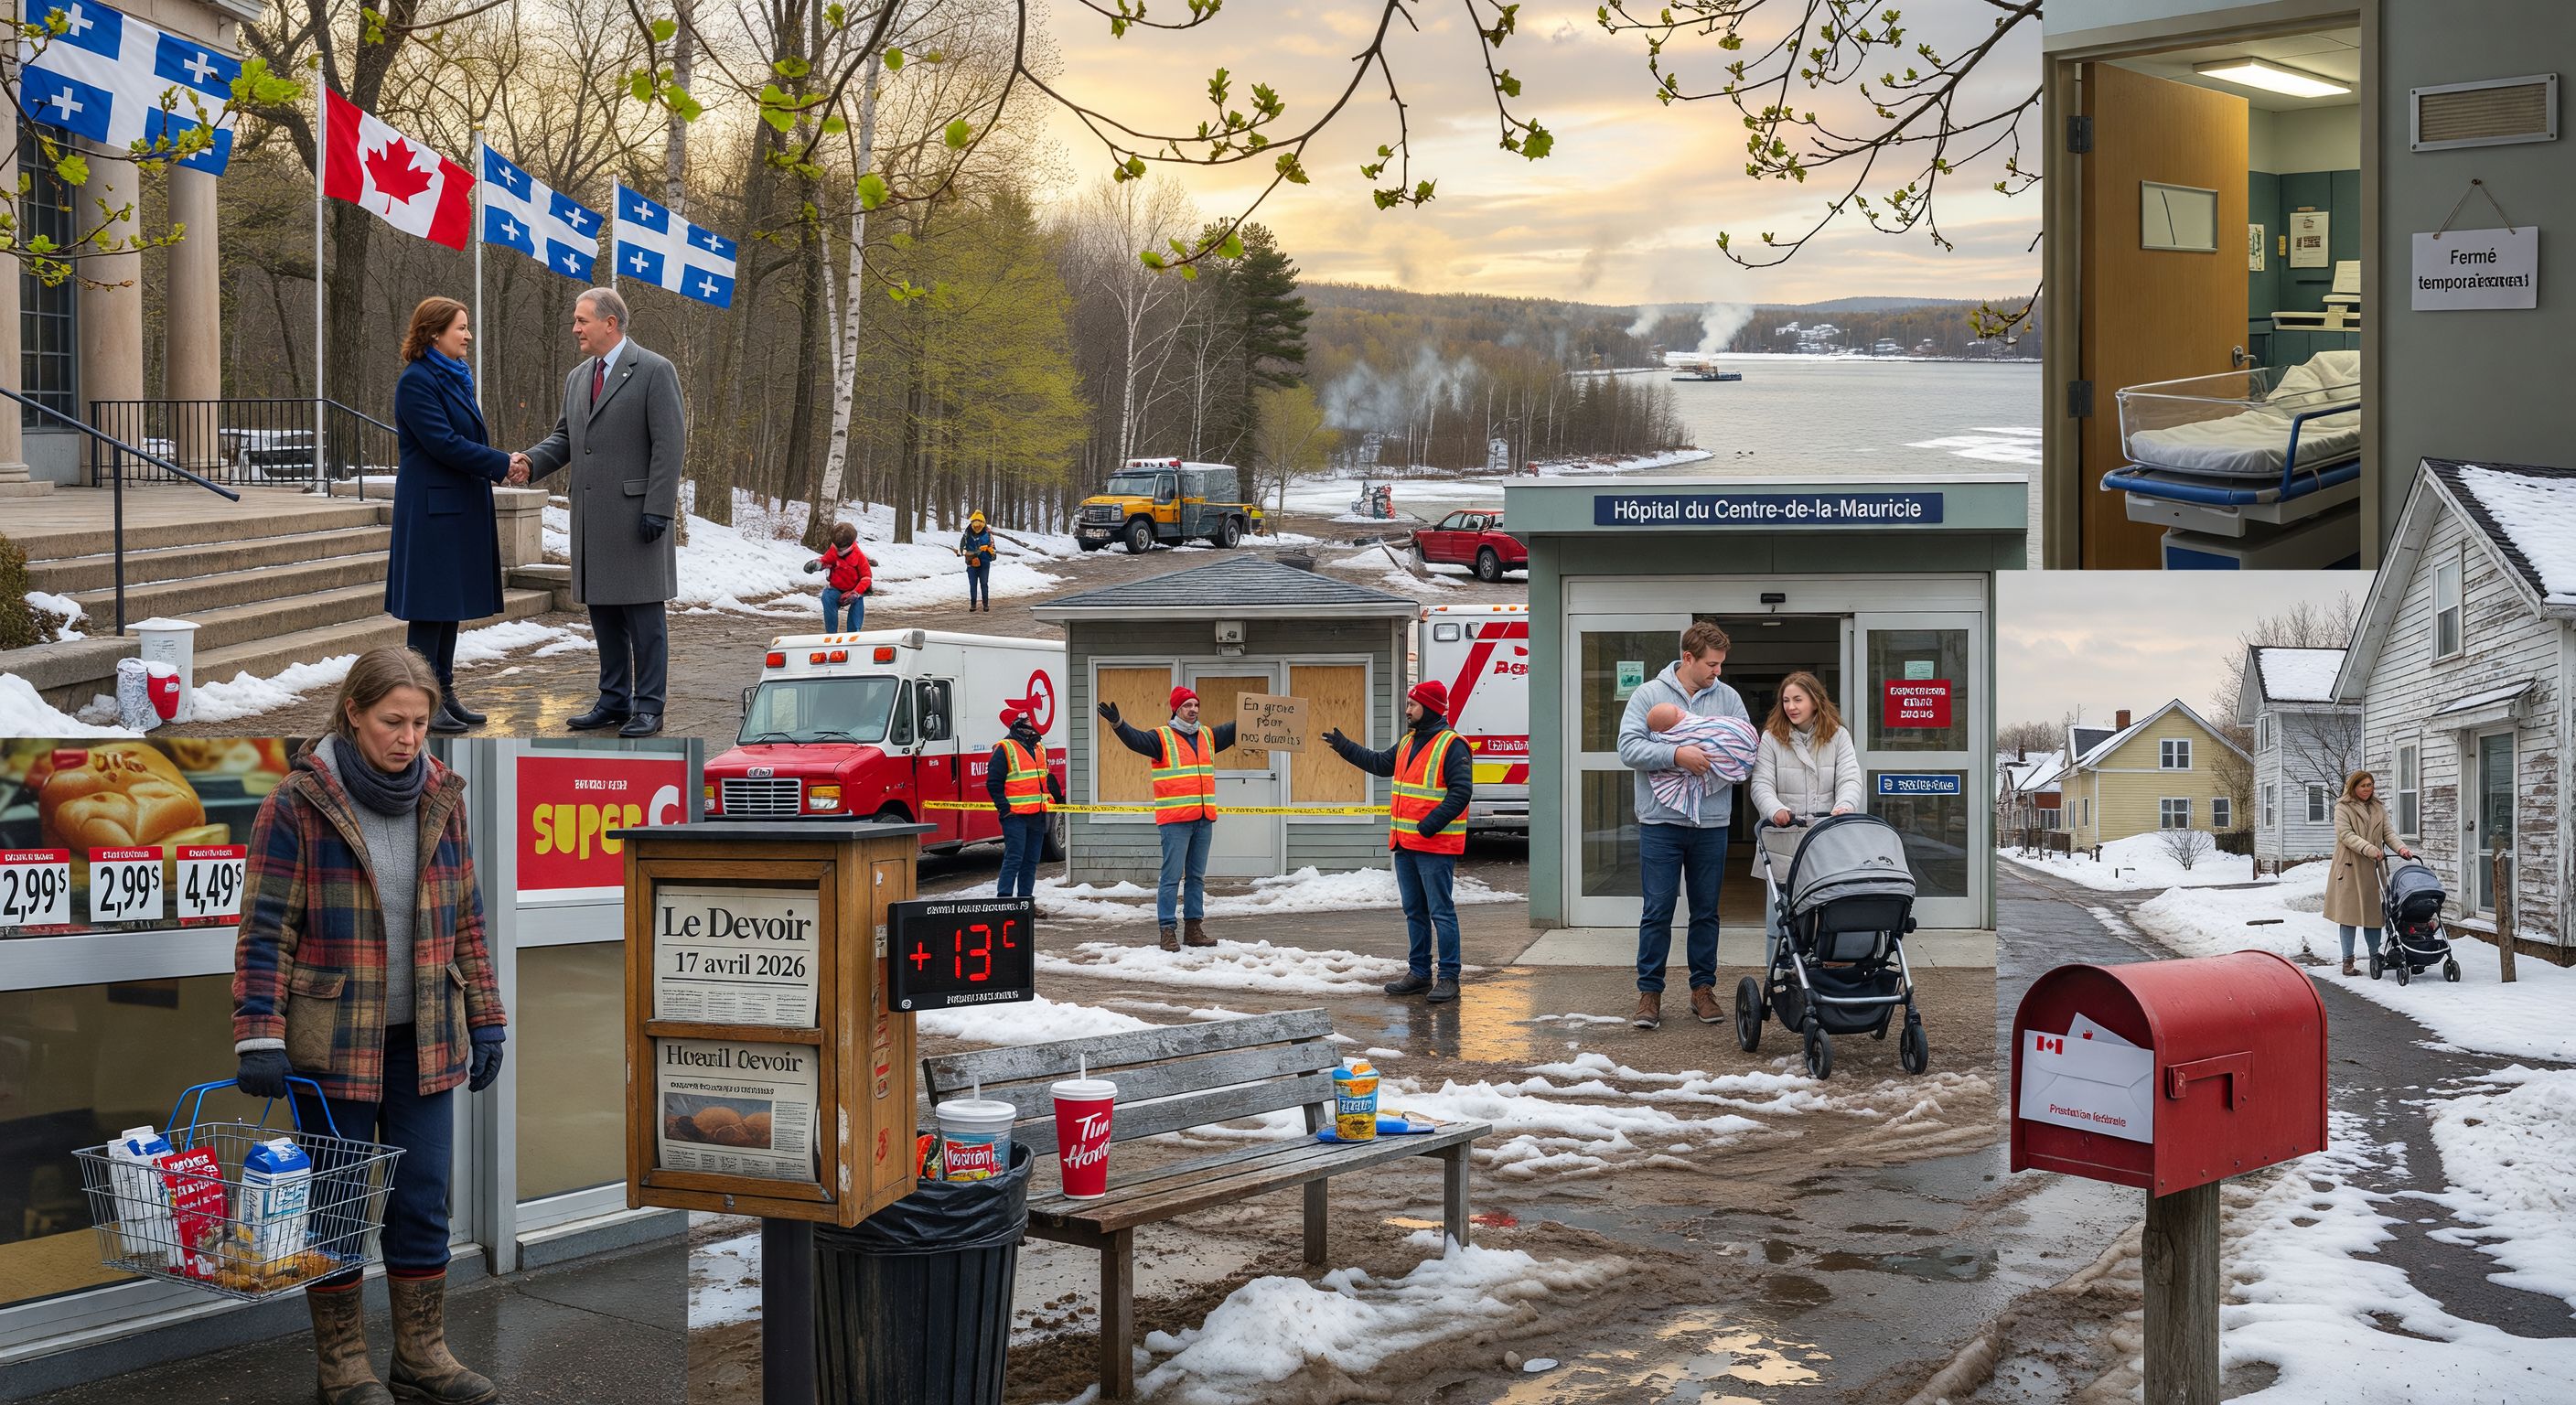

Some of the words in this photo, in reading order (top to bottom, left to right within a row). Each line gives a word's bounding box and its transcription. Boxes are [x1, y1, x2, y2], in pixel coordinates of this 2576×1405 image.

[2450, 247, 2497, 265] Fermé
[1614, 499, 1680, 524] Hôpital
[1685, 500, 1710, 519] du
[1714, 499, 1922, 520] Centre-de-la-Mauricie
[1243, 697, 1259, 711] En
[648, 784, 680, 827] C
[3, 867, 67, 923] 2,99$
[100, 864, 160, 918] 2,99$
[185, 863, 242, 915] 4,49$
[661, 906, 701, 938] Le
[707, 907, 811, 941] Devoir
[675, 952, 699, 973] 17
[704, 953, 750, 974] avril
[757, 954, 806, 978] 2026
